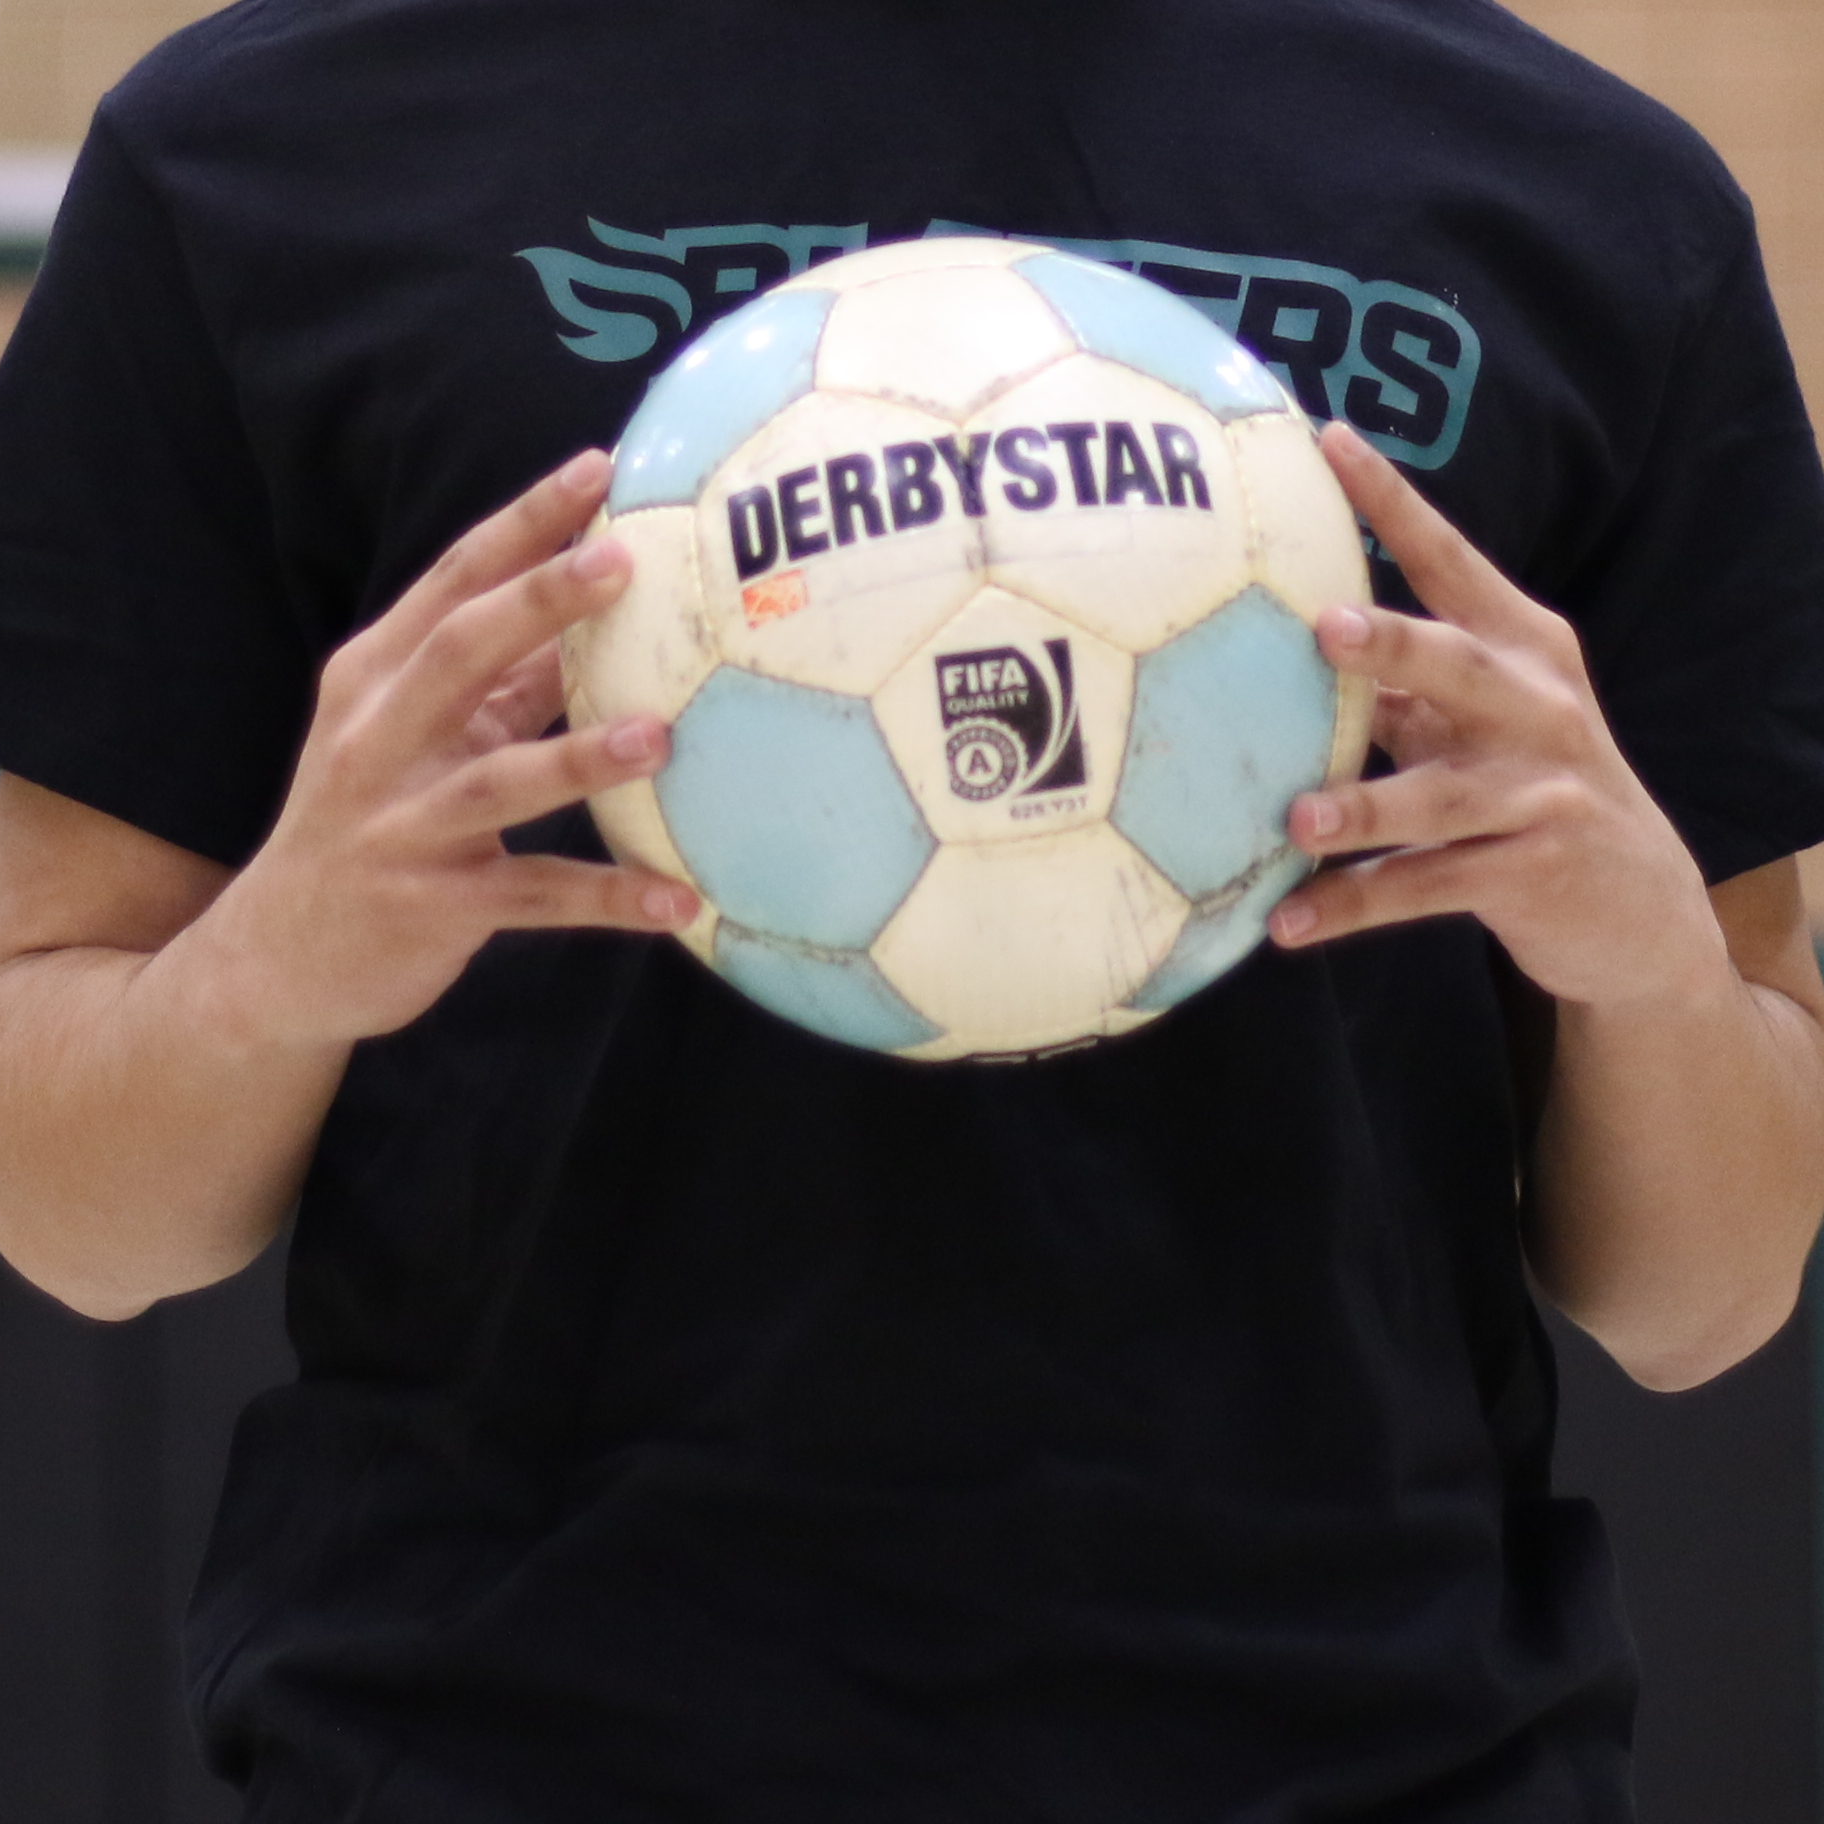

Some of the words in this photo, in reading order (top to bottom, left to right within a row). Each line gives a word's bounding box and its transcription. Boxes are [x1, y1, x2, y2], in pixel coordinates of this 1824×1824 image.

[727, 421, 1214, 583] DERBYSTAR
[942, 657, 1028, 696] FIFA
[945, 690, 1029, 715] QUALITY
